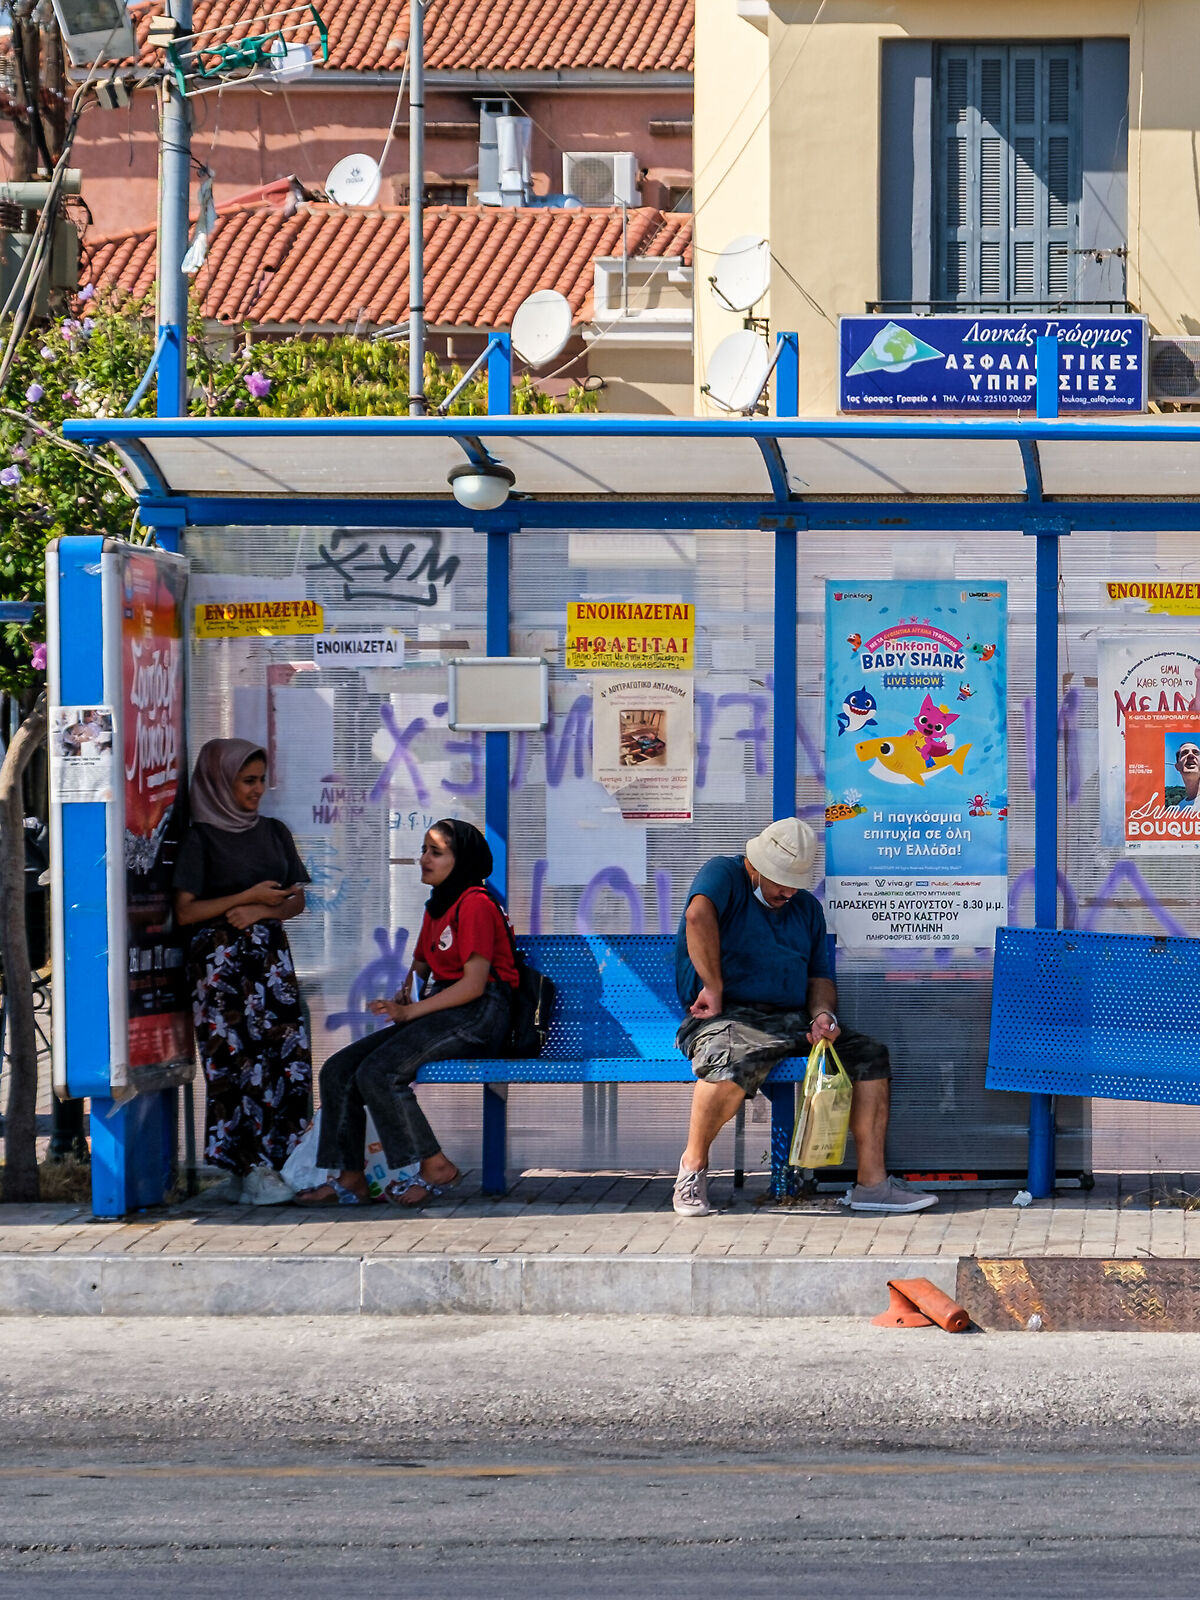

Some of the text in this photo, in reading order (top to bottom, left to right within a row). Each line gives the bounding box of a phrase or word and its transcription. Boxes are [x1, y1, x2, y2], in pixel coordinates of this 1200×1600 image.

[962, 322, 1132, 348] Λουκάς Γεώργιος
[969, 374, 1118, 391] ΥΠΗΡΣΙΕΣ
[846, 394, 861, 405] 1ος
[863, 393, 893, 405] όροφος
[897, 394, 928, 405] Γραφείο
[931, 394, 937, 403] 4
[984, 394, 1007, 403] 22510
[1008, 394, 1032, 403] 20627
[844, 592, 872, 602] pinkfong
[204, 600, 317, 620] ΕΝΟΙΚΙΑΖΕΤΑΙ
[577, 604, 689, 620] ΕΝΟΙΚΙΑΖΕΤΑΙ
[316, 639, 398, 656] ΕΝΟΙΚΙΑΖΕΤΑΙ
[576, 636, 688, 653] ΠΩΛΕΙΤΑΙ
[885, 641, 939, 653] Pinkfong
[861, 652, 966, 670] BABY SHARK
[1160, 665, 1181, 675] ΕΙΜΑΙ
[887, 677, 940, 686] LIVE SHOW
[1136, 677, 1158, 689] ΚΑΘΕ
[1160, 677, 1183, 688] ΦΟΡΑ
[873, 810, 962, 826] Η παγκόσμια
[864, 828, 971, 842] επιτυχία σε όλη
[877, 844, 961, 859] την Ελλάδα!
[887, 880, 913, 888] viva.gr
[829, 900, 887, 910] ΠΑΡΑΣΚΕΥΗ
[890, 900, 896, 910] 5
[898, 900, 954, 910] ΑΥΓΟΥΣΤΟΥ
[963, 900, 983, 910] 8.30
[985, 901, 1004, 911] μ.μ.
[872, 912, 959, 921] ΘΕΑΤΡΟ ΚΑΣΤΡΟΥ
[890, 923, 943, 933] ΜΥΤΙΛΗΝΗ
[866, 934, 913, 942] ΠΛΗΡΟΦΟΡΙΕΣ:
